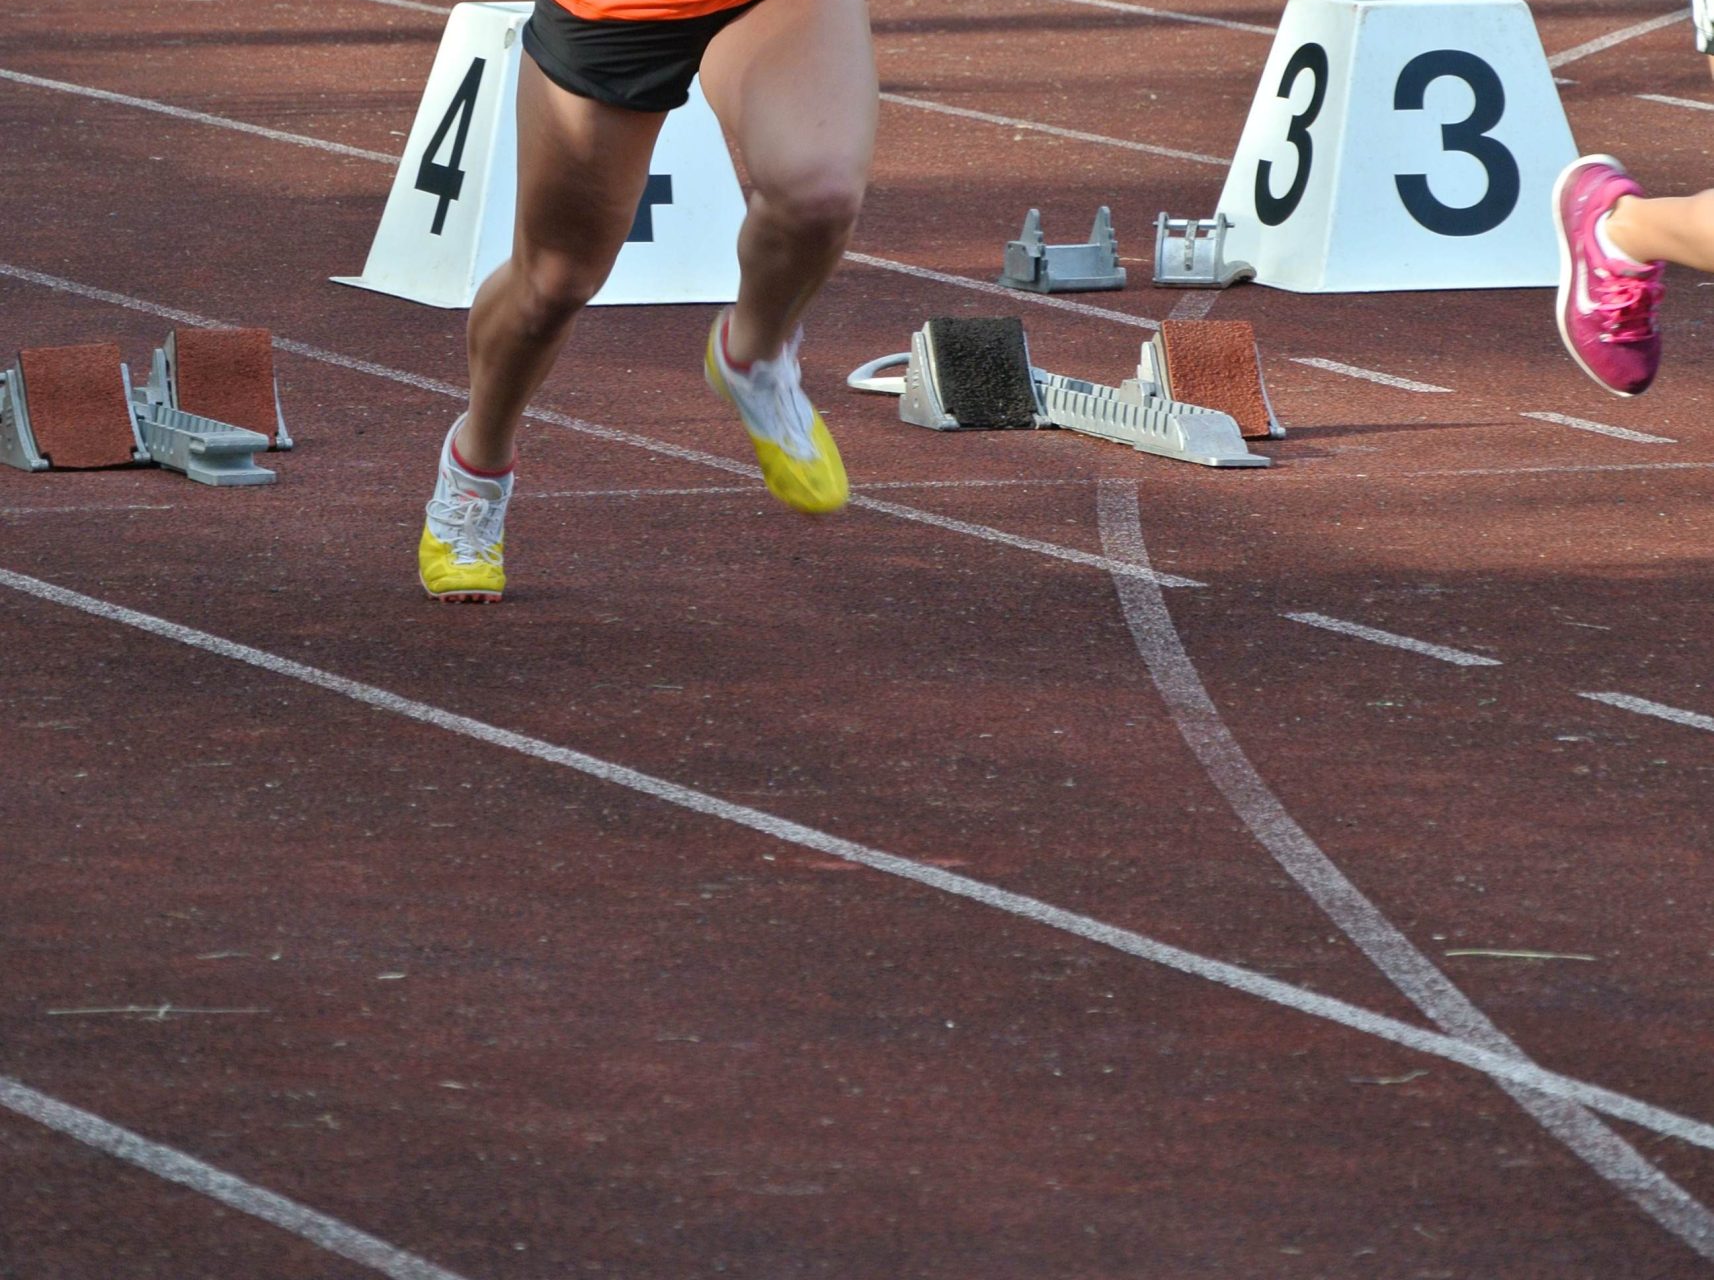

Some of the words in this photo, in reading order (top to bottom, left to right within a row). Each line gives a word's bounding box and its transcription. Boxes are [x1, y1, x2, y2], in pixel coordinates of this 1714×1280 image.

[414, 57, 487, 236] 4
[1255, 42, 1329, 226] 3
[1393, 49, 1520, 236] 3
